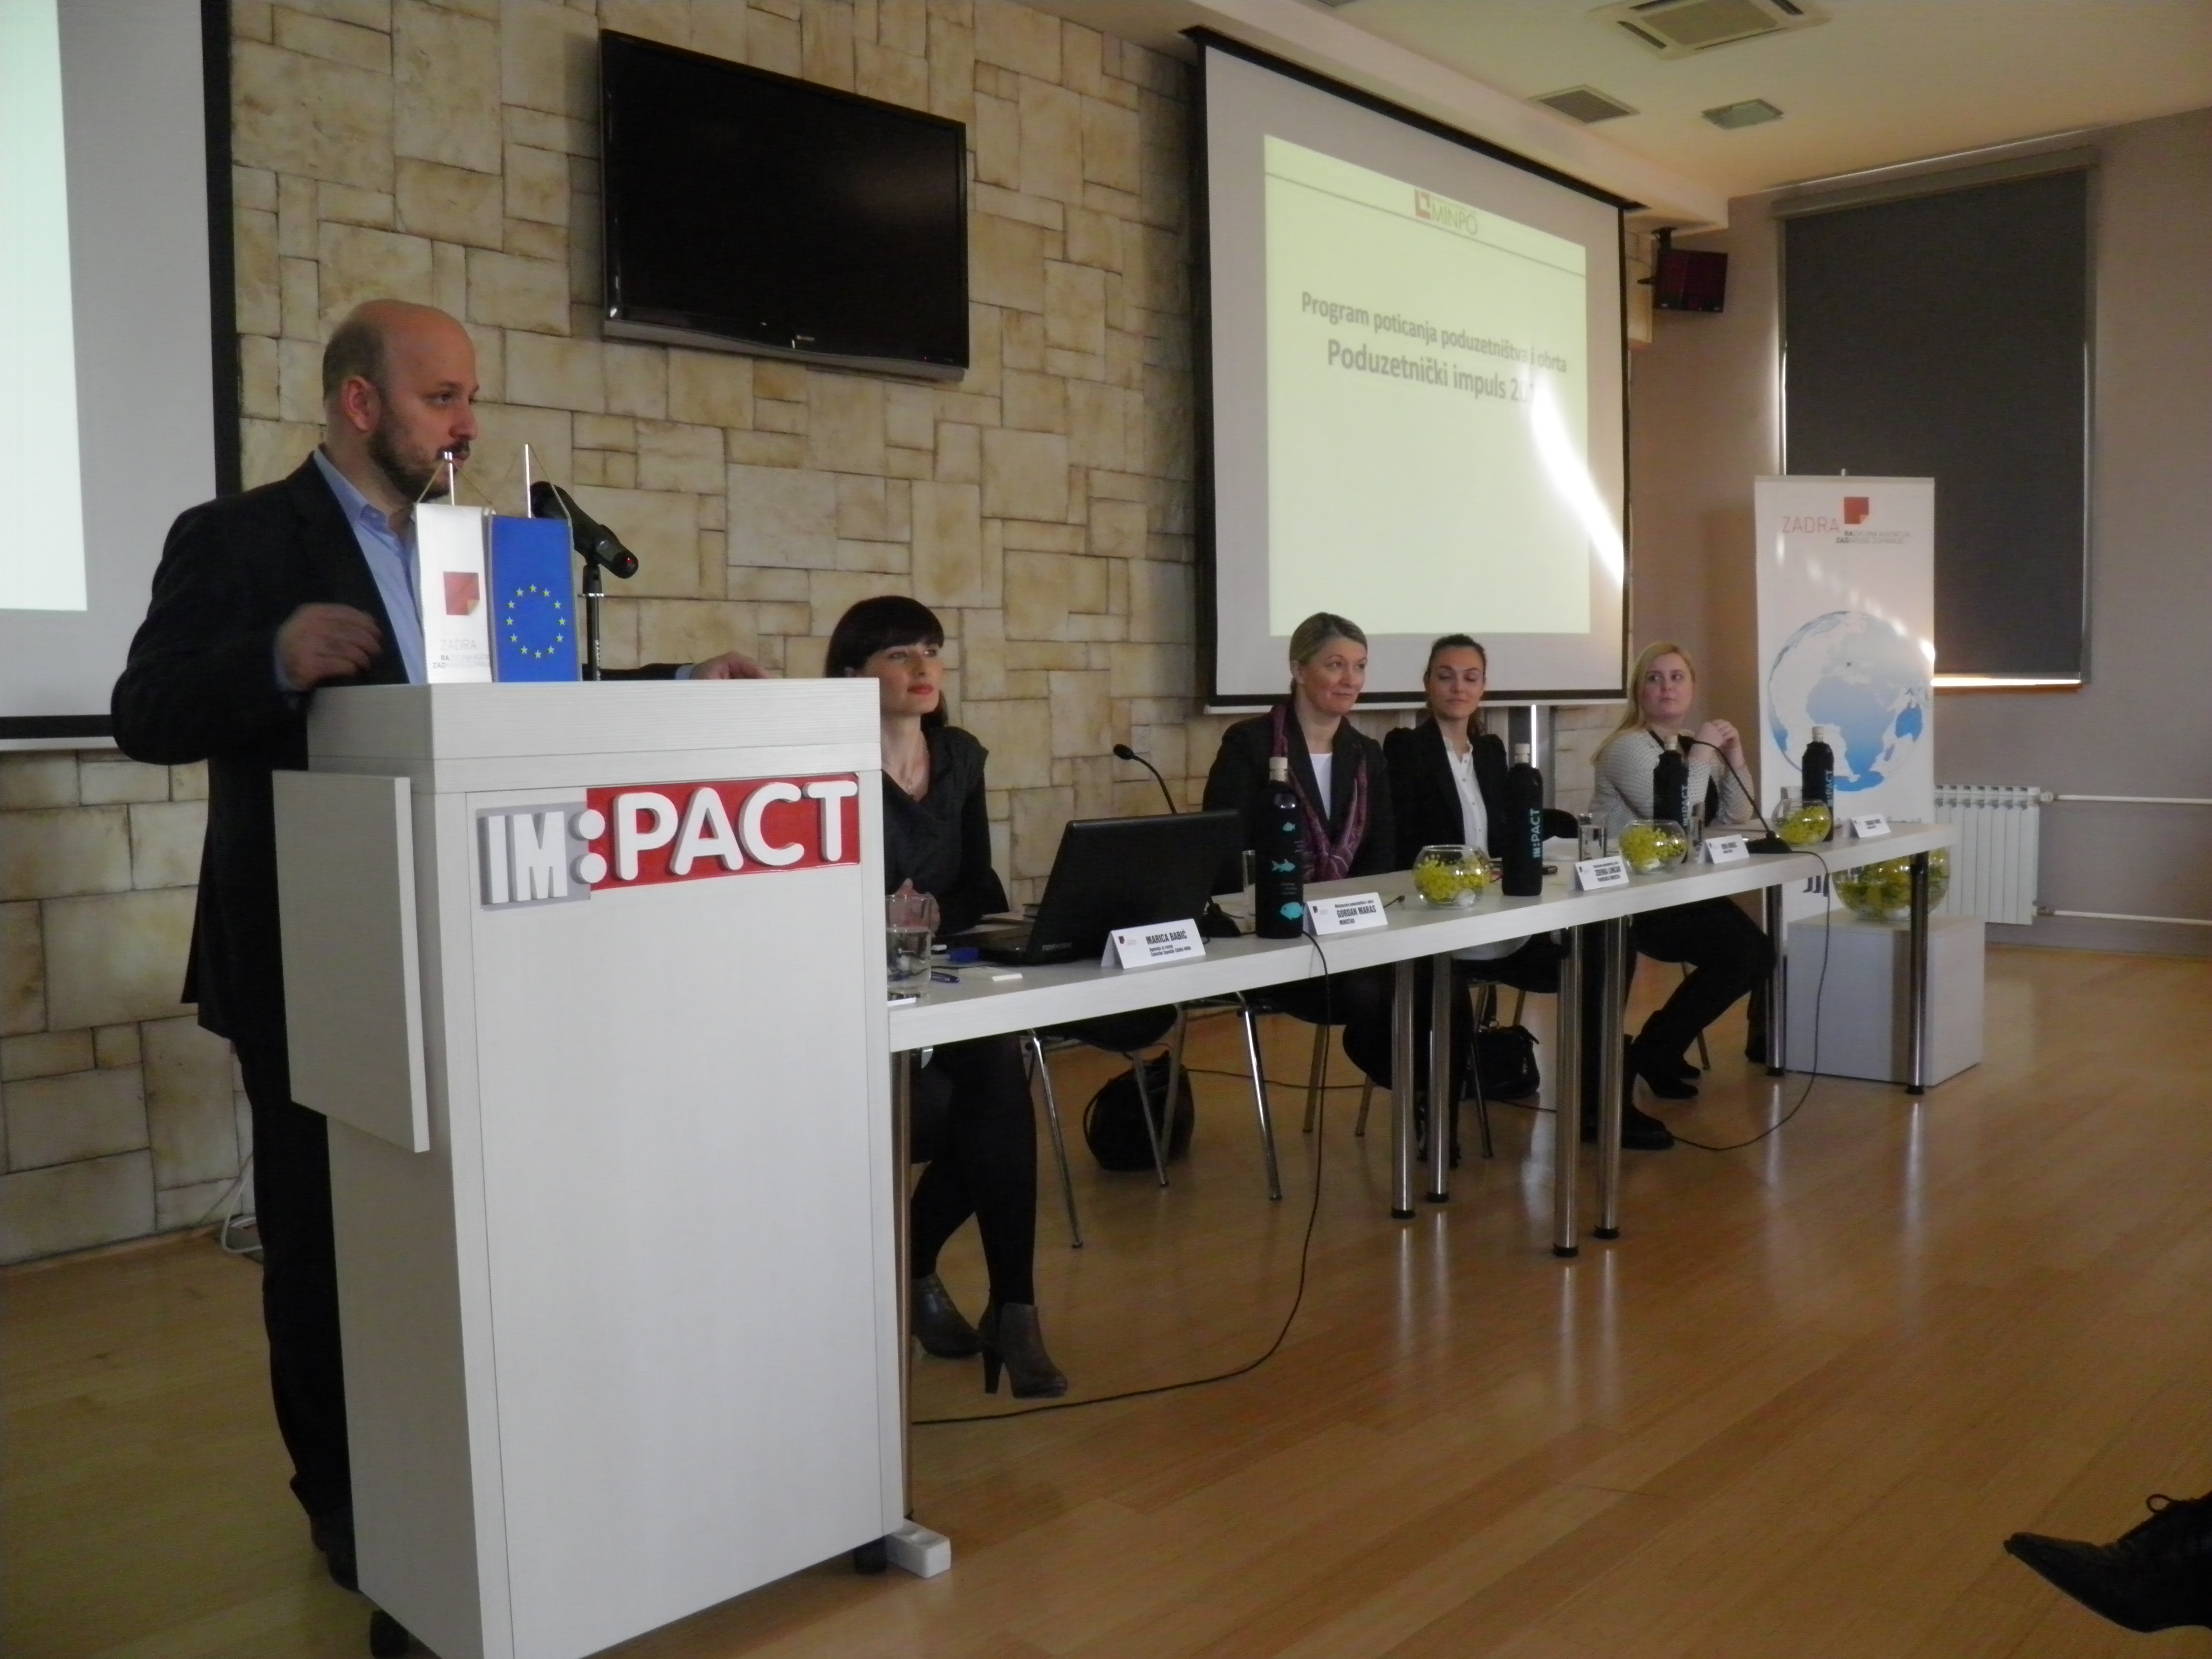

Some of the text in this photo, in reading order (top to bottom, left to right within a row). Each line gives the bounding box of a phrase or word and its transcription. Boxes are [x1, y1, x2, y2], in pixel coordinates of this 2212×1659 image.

[1432, 203, 1477, 235] MINPO
[1302, 291, 1369, 325] Program
[1373, 313, 1437, 346] poticanja
[1441, 328, 1528, 364] poduzetništva
[1537, 349, 1567, 373] obrta
[1328, 338, 1449, 387] Poduzetnički
[1453, 363, 1506, 399] impuls
[1782, 516, 1840, 533] ZADRA
[440, 639, 477, 651] ZADRA
[1358, 905, 1377, 915] MARAS
[1146, 933, 1169, 945] MARICA
